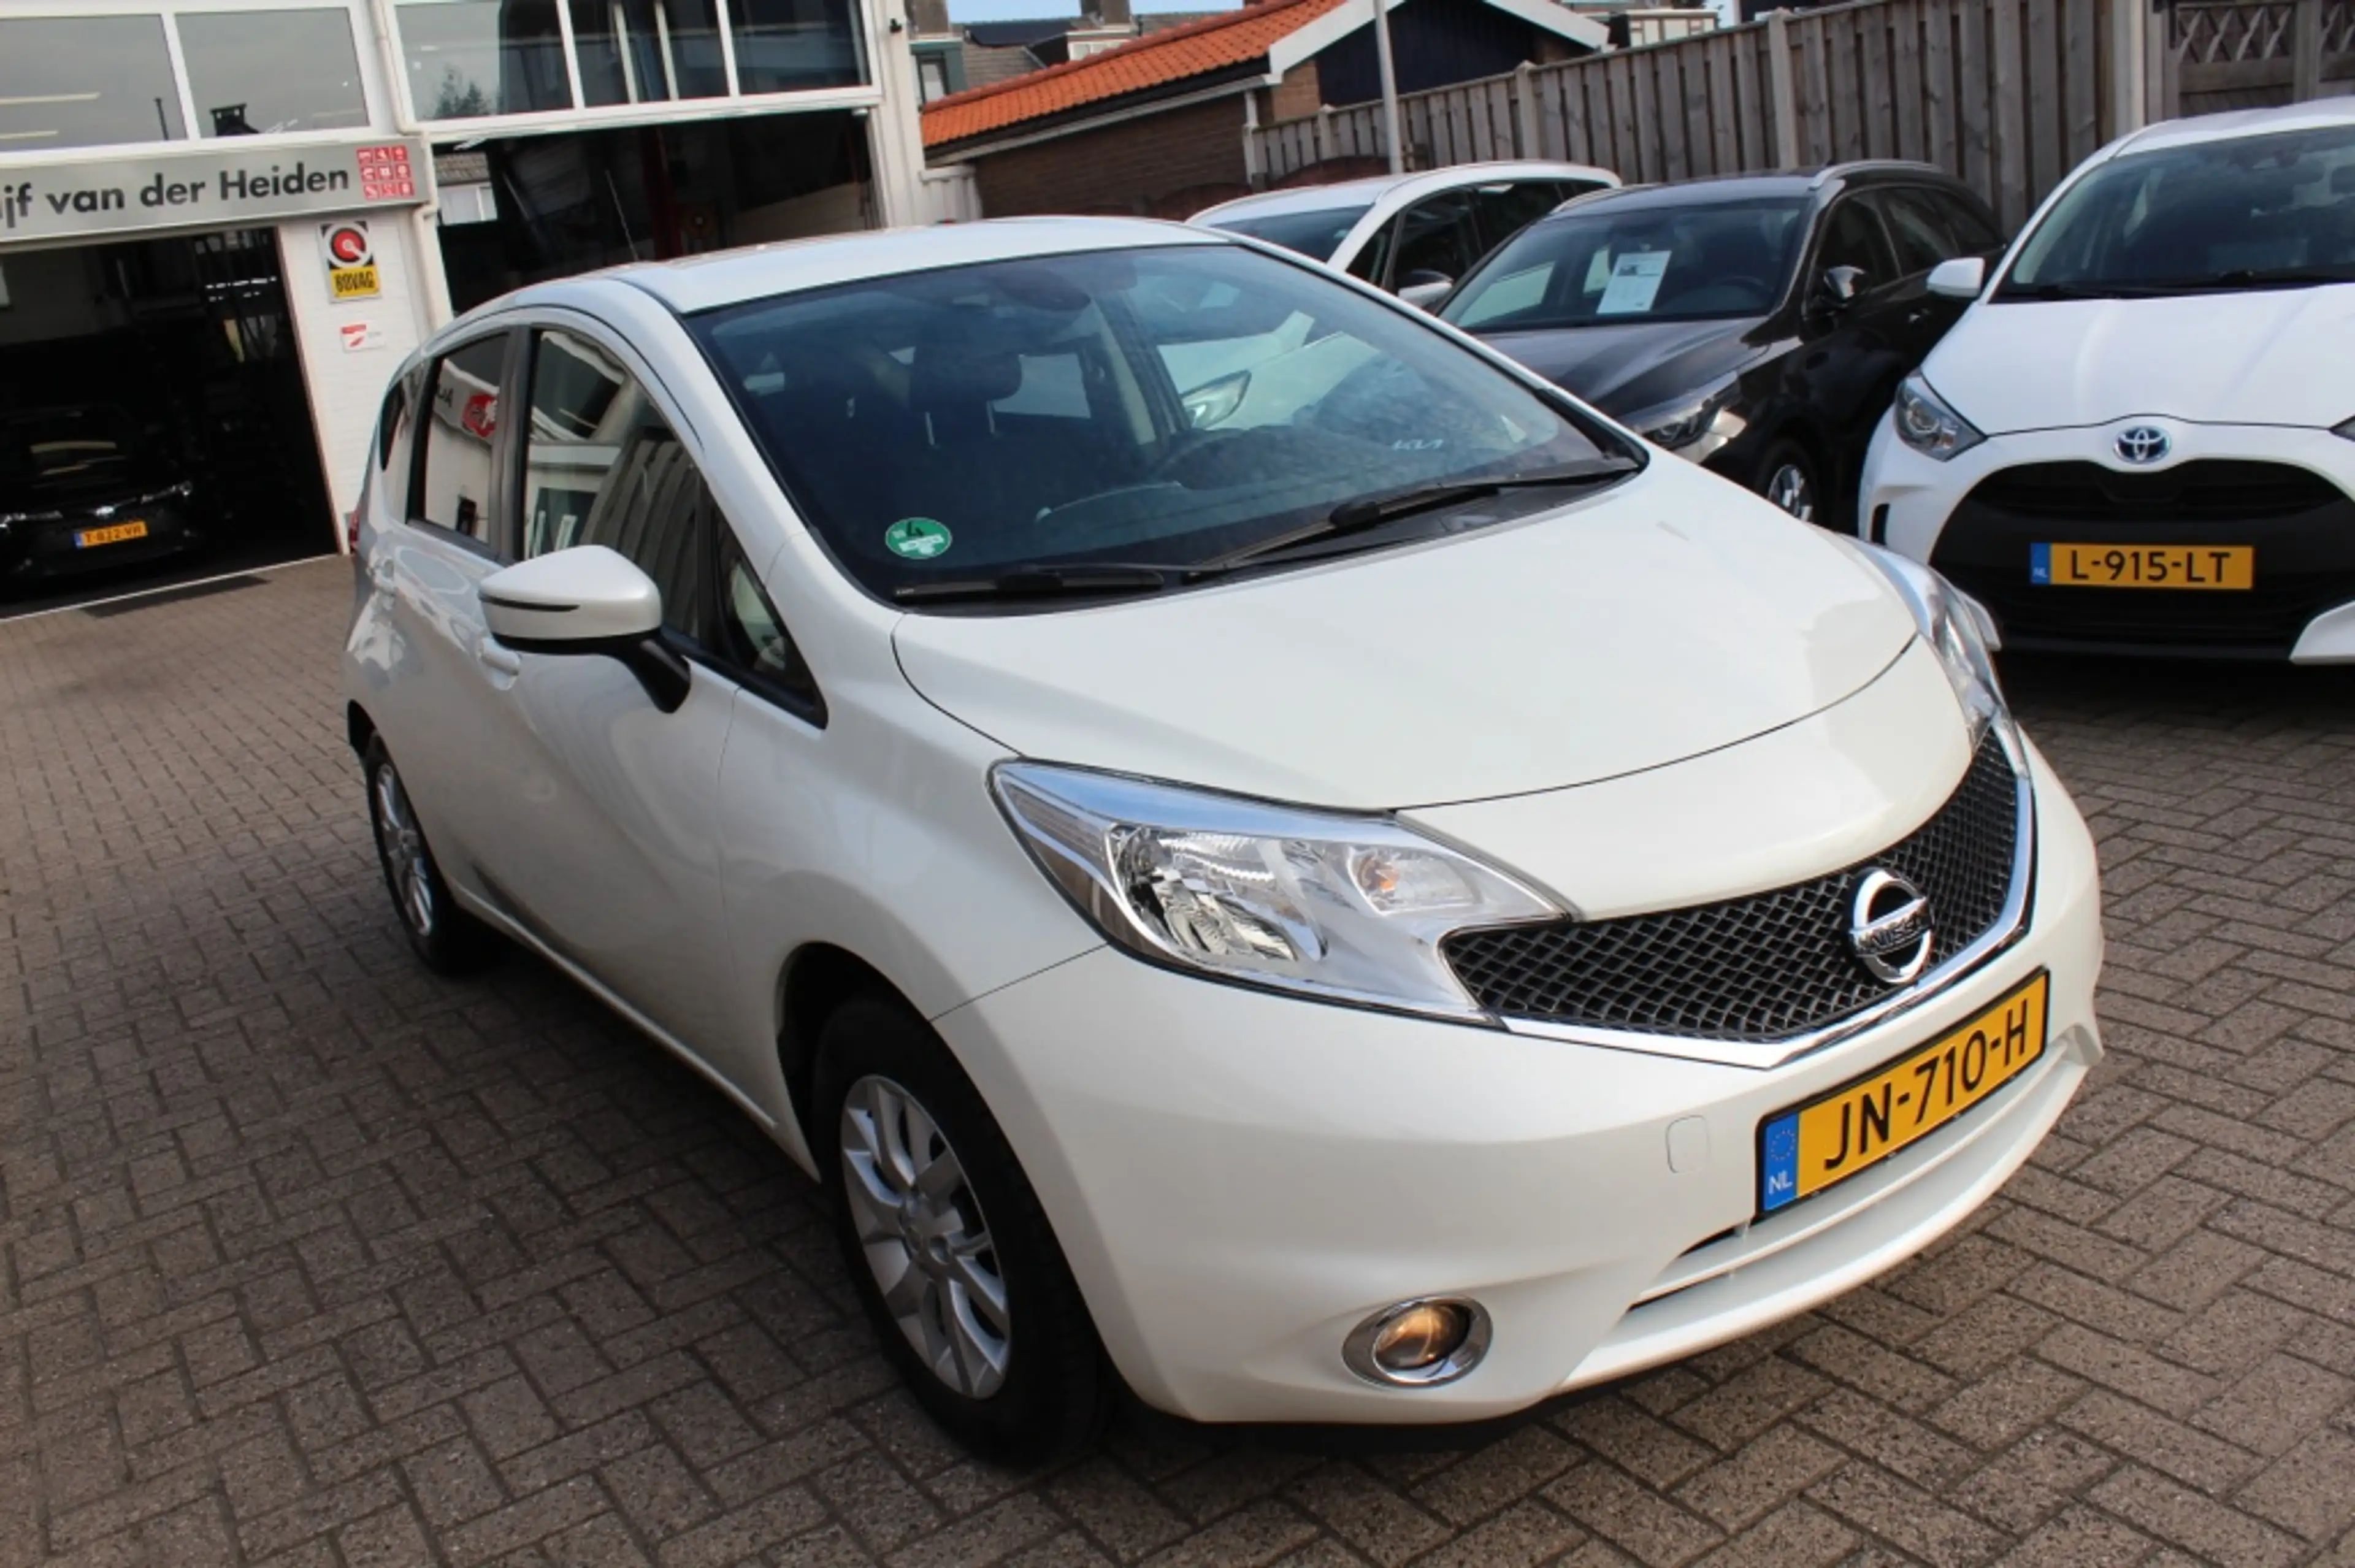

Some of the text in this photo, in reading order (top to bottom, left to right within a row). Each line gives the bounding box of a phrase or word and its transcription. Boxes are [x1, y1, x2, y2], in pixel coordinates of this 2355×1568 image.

[0, 162, 348, 229] jf van der Heiden
[335, 270, 375, 293] BOVAG
[2071, 549, 2231, 583] L-915-LT
[1824, 999, 2028, 1171] JN-710-H
[1768, 1170, 1793, 1195] NL
